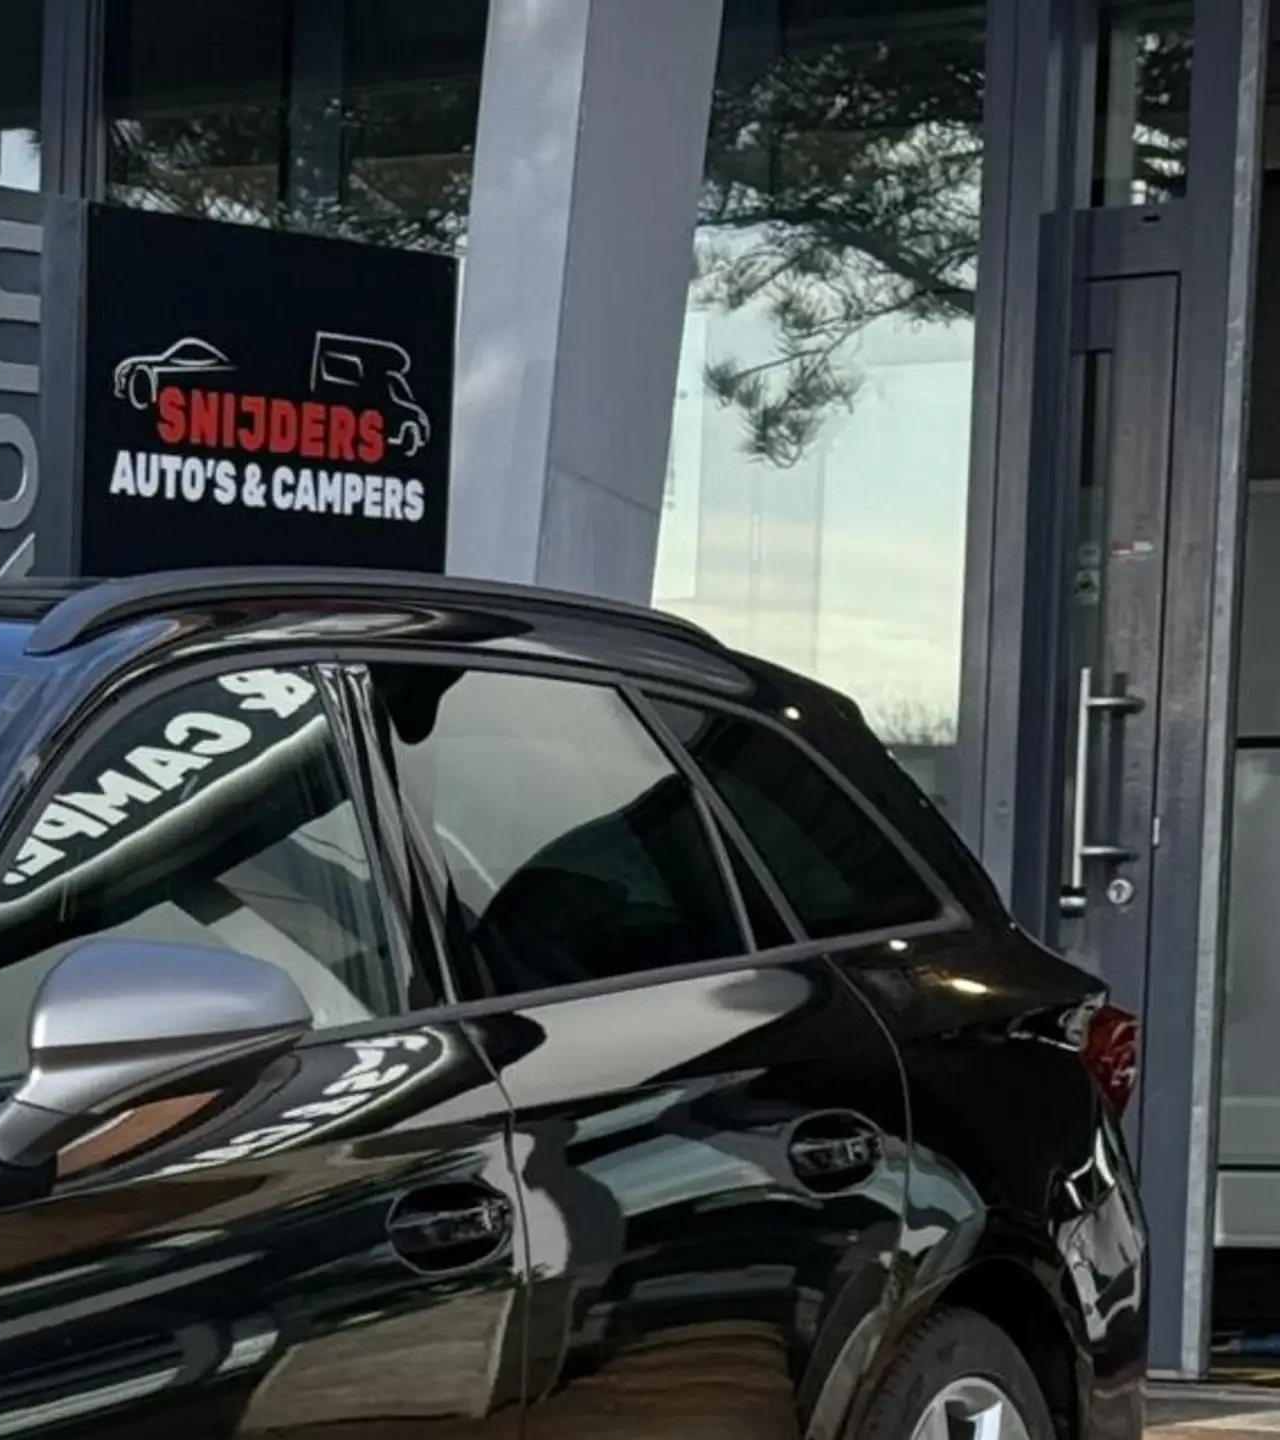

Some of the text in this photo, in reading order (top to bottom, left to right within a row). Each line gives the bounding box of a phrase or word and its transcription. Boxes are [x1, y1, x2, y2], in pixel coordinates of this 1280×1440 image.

[156, 386, 385, 463] SNIJDERS
[110, 450, 425, 521] AUTO'S & CAMPERS
